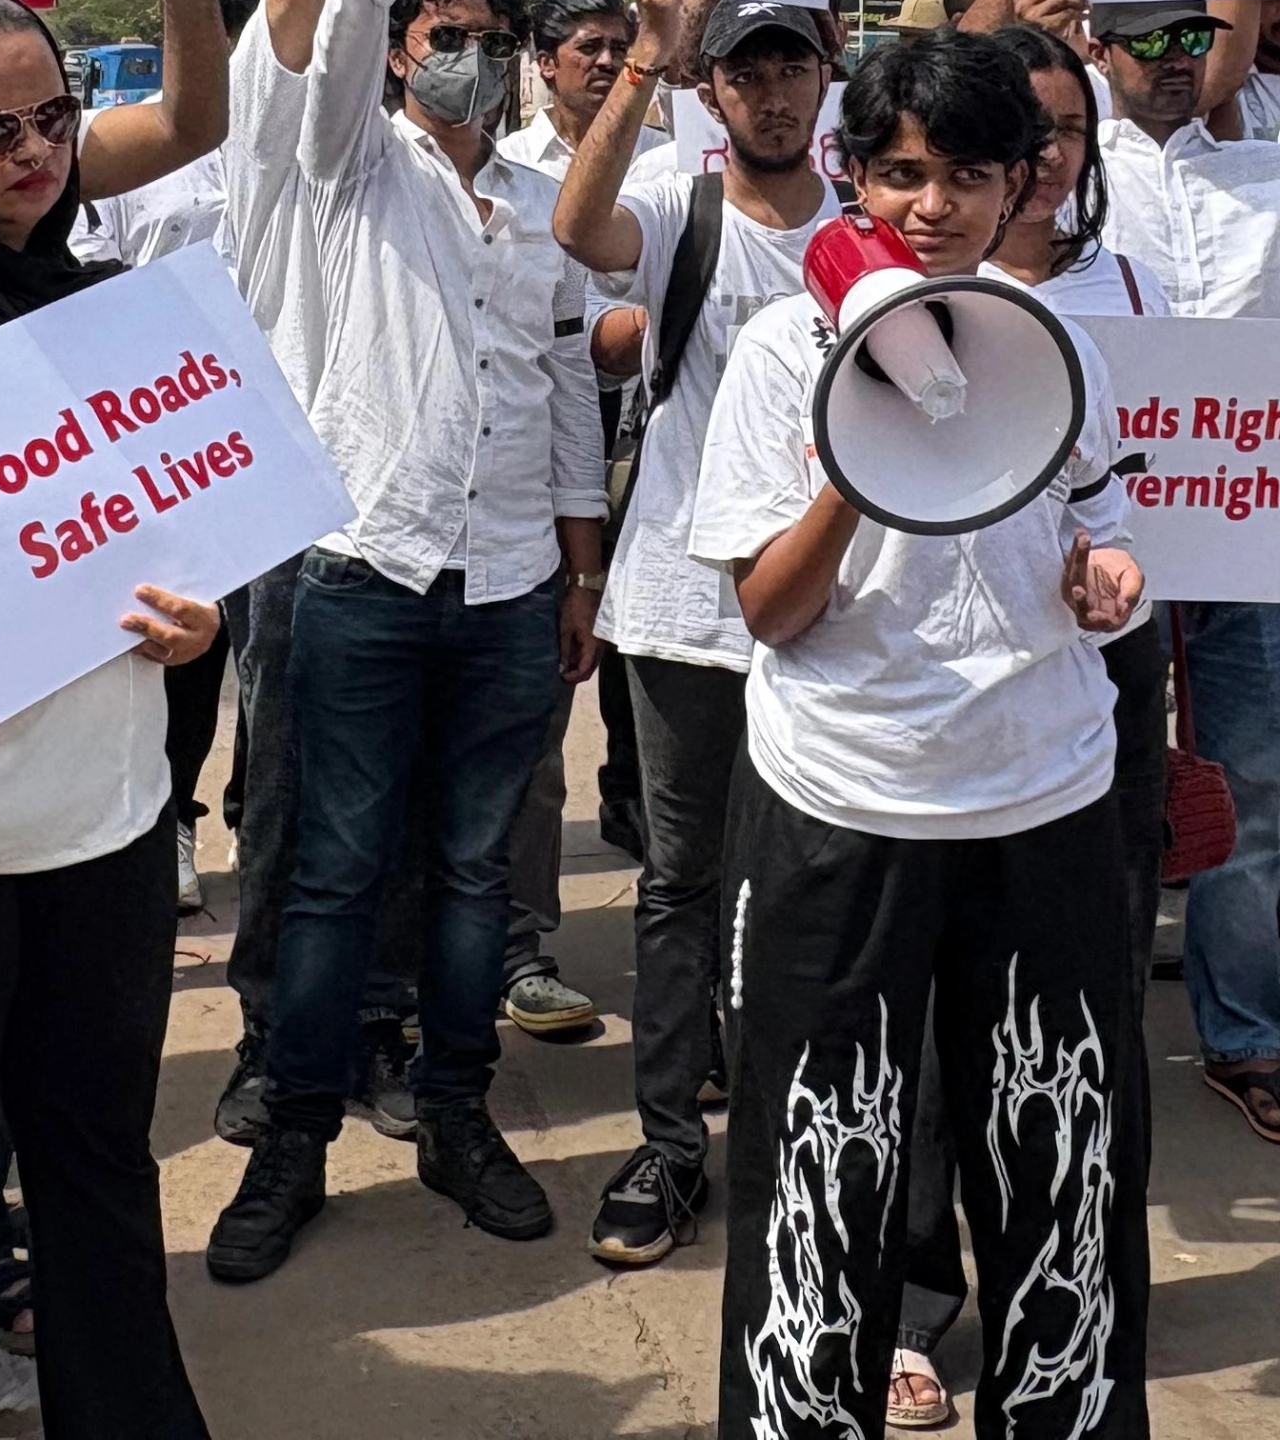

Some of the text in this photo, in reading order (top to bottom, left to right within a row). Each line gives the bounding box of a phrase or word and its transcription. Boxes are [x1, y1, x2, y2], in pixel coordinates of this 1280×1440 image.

[85, 351, 241, 442] Roads,
[19, 431, 253, 578] Safe Lives
